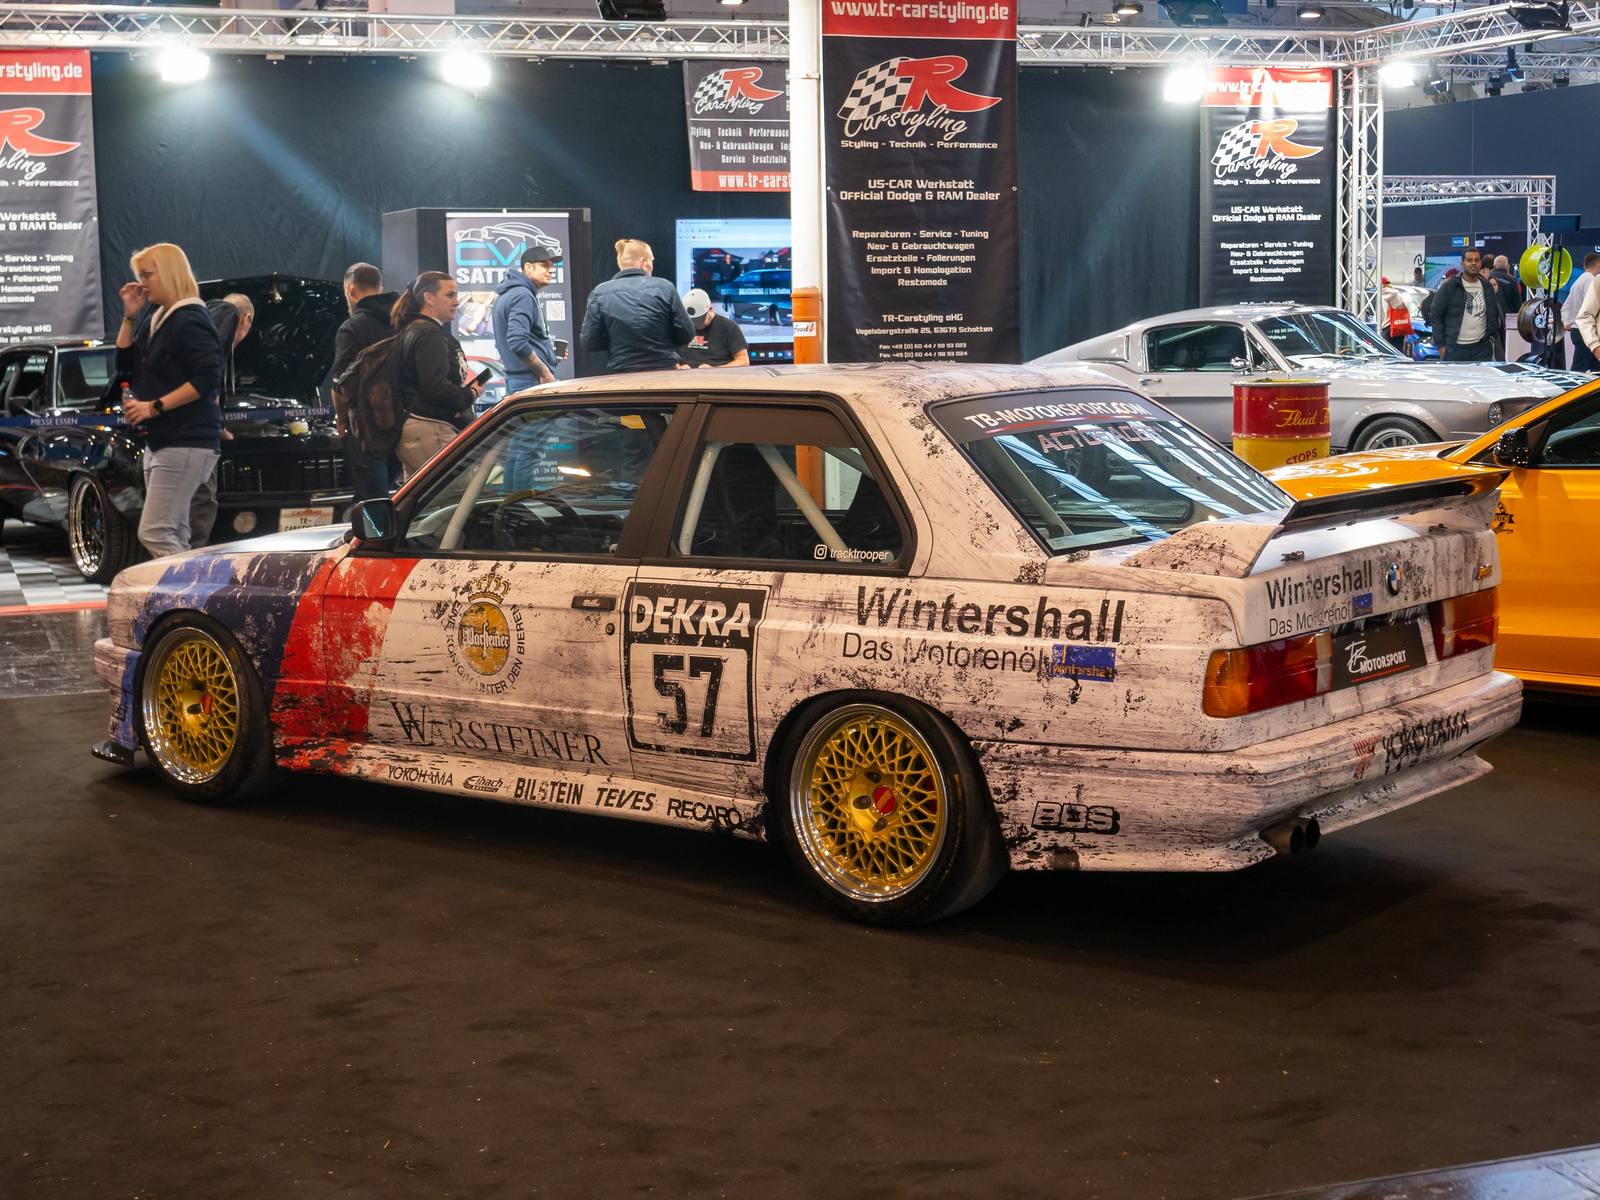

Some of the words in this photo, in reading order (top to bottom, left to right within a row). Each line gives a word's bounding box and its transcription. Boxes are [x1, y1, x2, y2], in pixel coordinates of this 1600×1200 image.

[831, 0, 1009, 24] www.tr-carstyling.de
[695, 97, 764, 114] Carstyling
[844, 104, 968, 141] Carstyling
[718, 127, 742, 137] Technik
[749, 127, 789, 137] Performance
[722, 141, 774, 152] Gebrauchtwagen
[840, 140, 879, 149] Styling
[936, 141, 998, 149] Performance
[721, 155, 746, 164] Service
[752, 155, 787, 164] Ersatzteile
[1216, 152, 1298, 179] Carstyling
[868, 179, 912, 189] US-CAR
[916, 179, 975, 189] Werkstatt
[840, 191, 883, 200] Official
[887, 191, 922, 202] Dodge
[925, 192, 933, 200] &
[937, 191, 963, 200] RAM
[966, 191, 1000, 200] Dealer
[1230, 206, 1260, 214] US-CAR
[1262, 205, 1303, 213] Werkstatt
[1243, 214, 1266, 223] Dodge
[1297, 213, 1322, 221] Dealer
[9, 222, 17, 230] &
[20, 222, 46, 230] RAM
[49, 222, 83, 230] Dealer
[852, 230, 911, 239] Reparaturen
[919, 230, 952, 238] Service
[960, 230, 989, 239] Tuning
[901, 242, 975, 251] Gebrauchtwagen
[45, 254, 74, 262] Tuning
[926, 254, 976, 263] Folierungen
[456, 267, 564, 284] SATTEI
[871, 267, 901, 275] Import
[913, 266, 971, 275] Homologation
[898, 278, 948, 286] Restomods
[0, 285, 58, 294] Homologation
[882, 314, 943, 323] TR-Carstyling
[945, 313, 963, 321] oHG
[855, 327, 919, 336] Vogelsbergstraße
[225, 412, 248, 421] ESSEN
[285, 409, 307, 417] MESSE
[308, 408, 330, 416] ESSEN
[964, 402, 1152, 429] TB-MOTORSPORT.COM
[1275, 409, 1318, 427] Fluid
[30, 417, 53, 426] MESSE
[54, 417, 78, 426] ESSEN
[1286, 448, 1318, 465] STOPS
[830, 547, 889, 561] tracktrooper
[1266, 560, 1373, 610] Wintershall
[629, 595, 751, 638] DEKRA
[857, 585, 1126, 643] Wintershall
[510, 604, 525, 655] BIEREN
[1269, 617, 1293, 637] Das
[842, 631, 894, 662] Das
[903, 637, 1045, 674] Motorenöl
[1360, 650, 1406, 674] MOTORSPORT
[653, 653, 724, 738] 57
[388, 765, 453, 787] YOKOHAMA
[514, 777, 584, 806] BILSTEIN
[595, 787, 656, 811] TEVES
[667, 797, 742, 827] RECARO
